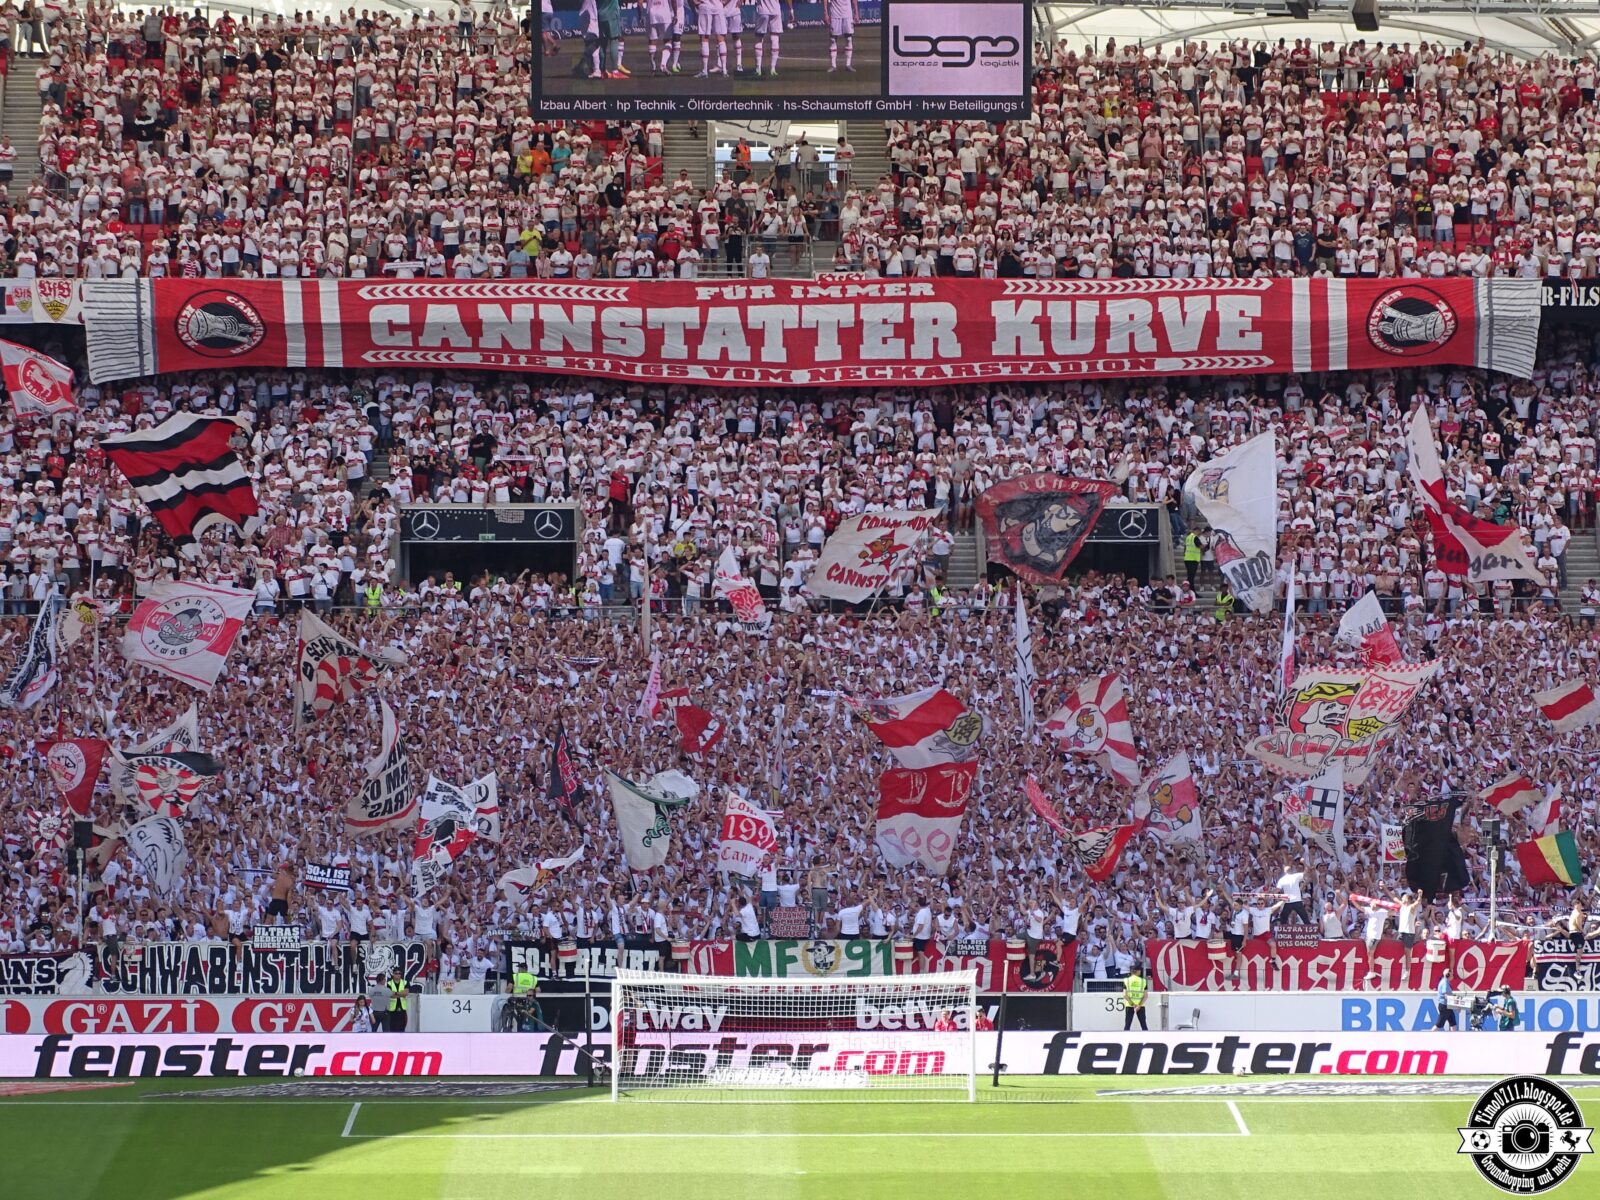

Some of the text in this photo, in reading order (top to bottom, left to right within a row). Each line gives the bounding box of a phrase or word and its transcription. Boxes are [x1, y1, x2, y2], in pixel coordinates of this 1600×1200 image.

[893, 25, 1020, 67] bgm
[980, 60, 1020, 68] logistik
[573, 100, 607, 110] Albert
[617, 100, 631, 113] hp
[634, 100, 676, 110] Technik
[688, 98, 774, 110] Ölfördertechnik
[783, 100, 873, 110] hs-Schaumstoff
[876, 100, 912, 110] GmbH
[922, 100, 946, 110] h+w
[949, 100, 1017, 113] Beteiligungs
[695, 281, 936, 301] FÜR IMMER
[368, 295, 1263, 363] CANNSTATTER KURVE
[480, 352, 1157, 383] DIE KINGS VOM NECKARSTADION
[333, 868, 351, 880] IST
[254, 926, 300, 936] ULTRAS
[254, 935, 300, 943] BEDEUTET
[735, 940, 799, 978] MF
[845, 940, 894, 977] 91
[1456, 944, 1519, 992] 97
[452, 999, 473, 1014] 34
[1105, 997, 1126, 1012] 35
[34, 1034, 443, 1077] fenster.com
[1043, 1032, 1448, 1075] fenster.com
